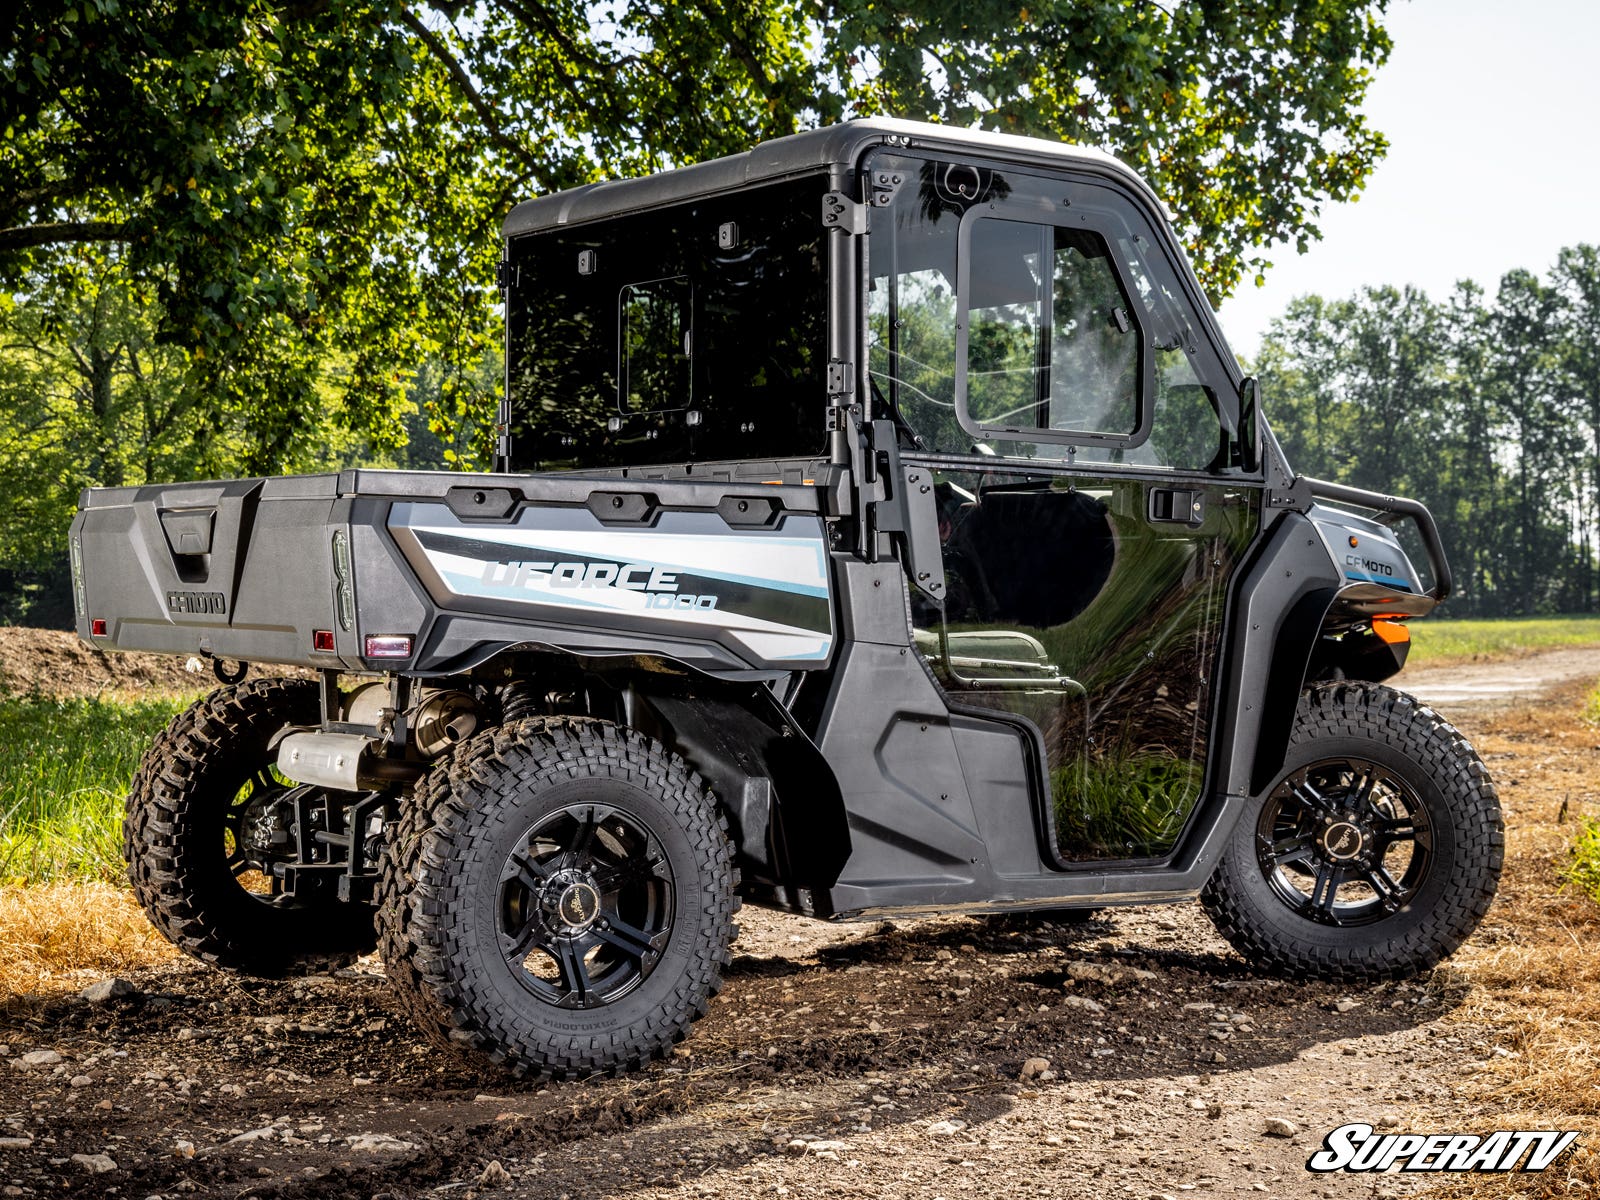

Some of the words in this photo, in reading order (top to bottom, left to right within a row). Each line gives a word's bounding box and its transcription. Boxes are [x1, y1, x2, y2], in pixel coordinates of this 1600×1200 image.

[481, 561, 685, 592] UFORCE
[1345, 555, 1393, 577] CFMOTO
[167, 591, 226, 614] CFMOTO
[644, 592, 719, 612] 1000
